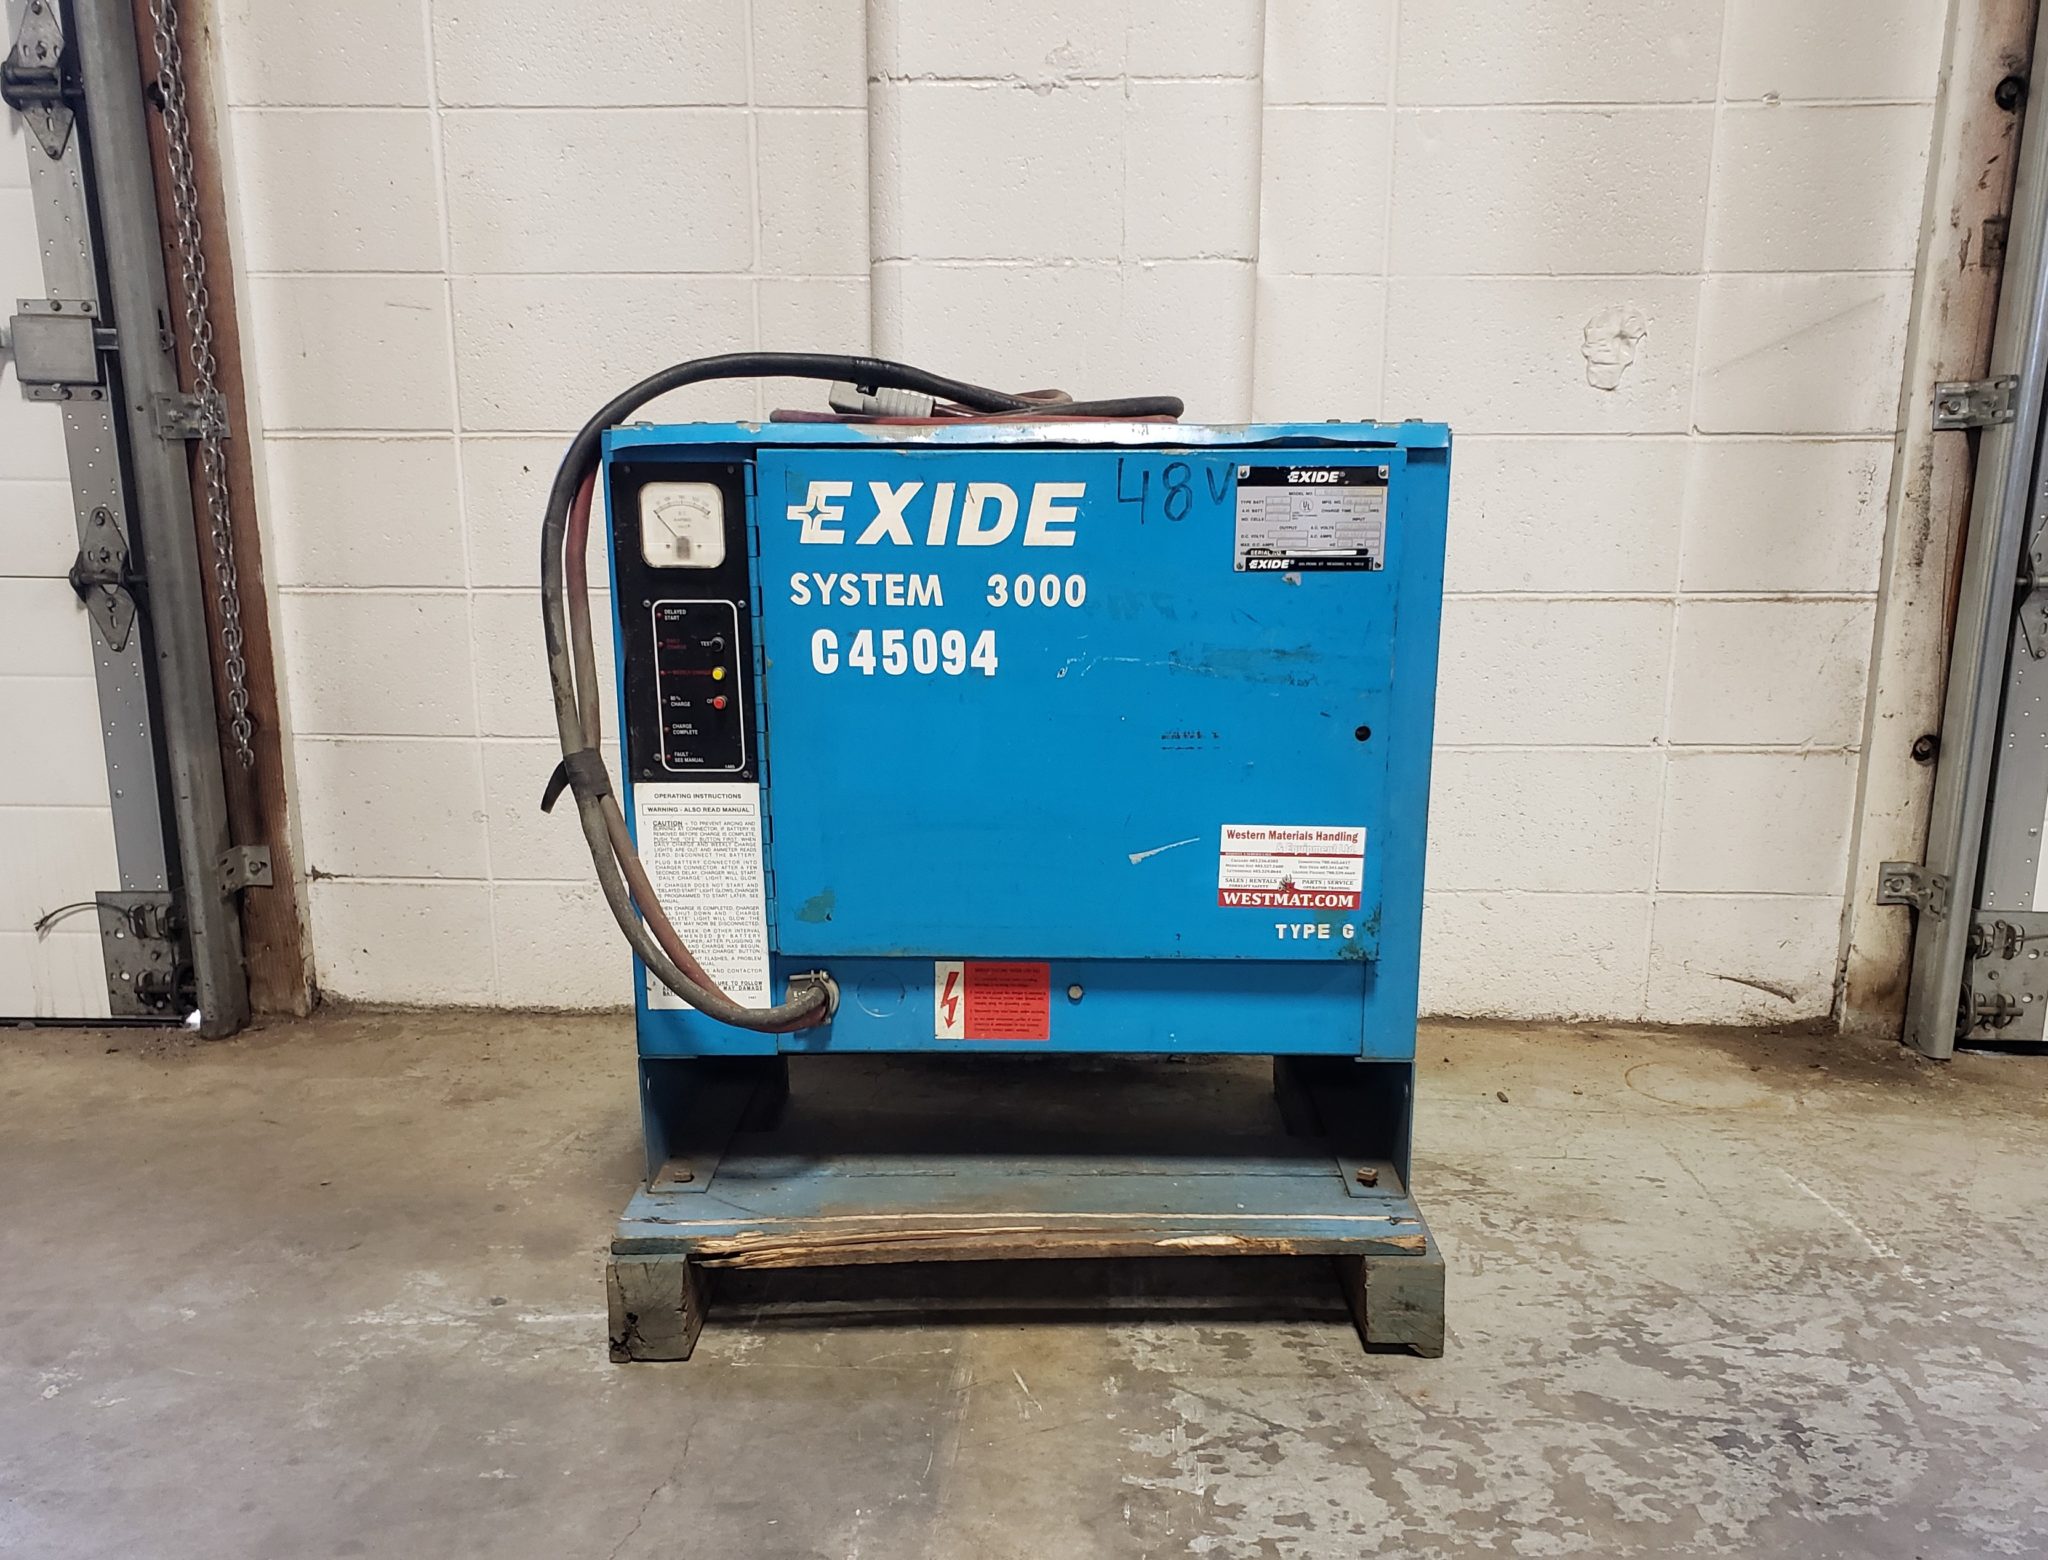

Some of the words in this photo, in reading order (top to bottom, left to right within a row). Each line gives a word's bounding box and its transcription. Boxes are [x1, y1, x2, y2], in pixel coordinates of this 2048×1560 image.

[787, 481, 1087, 547] EXIDE
[790, 572, 943, 607] SYSTEM
[987, 572, 1086, 607] 3000
[1227, 830, 1265, 839] Western
[1268, 831, 1313, 840] Materials
[1316, 832, 1358, 843] Handling
[1223, 892, 1353, 908] WESTMAT.COM
[1275, 923, 1330, 939] TYPE
[1342, 923, 1355, 939] G
